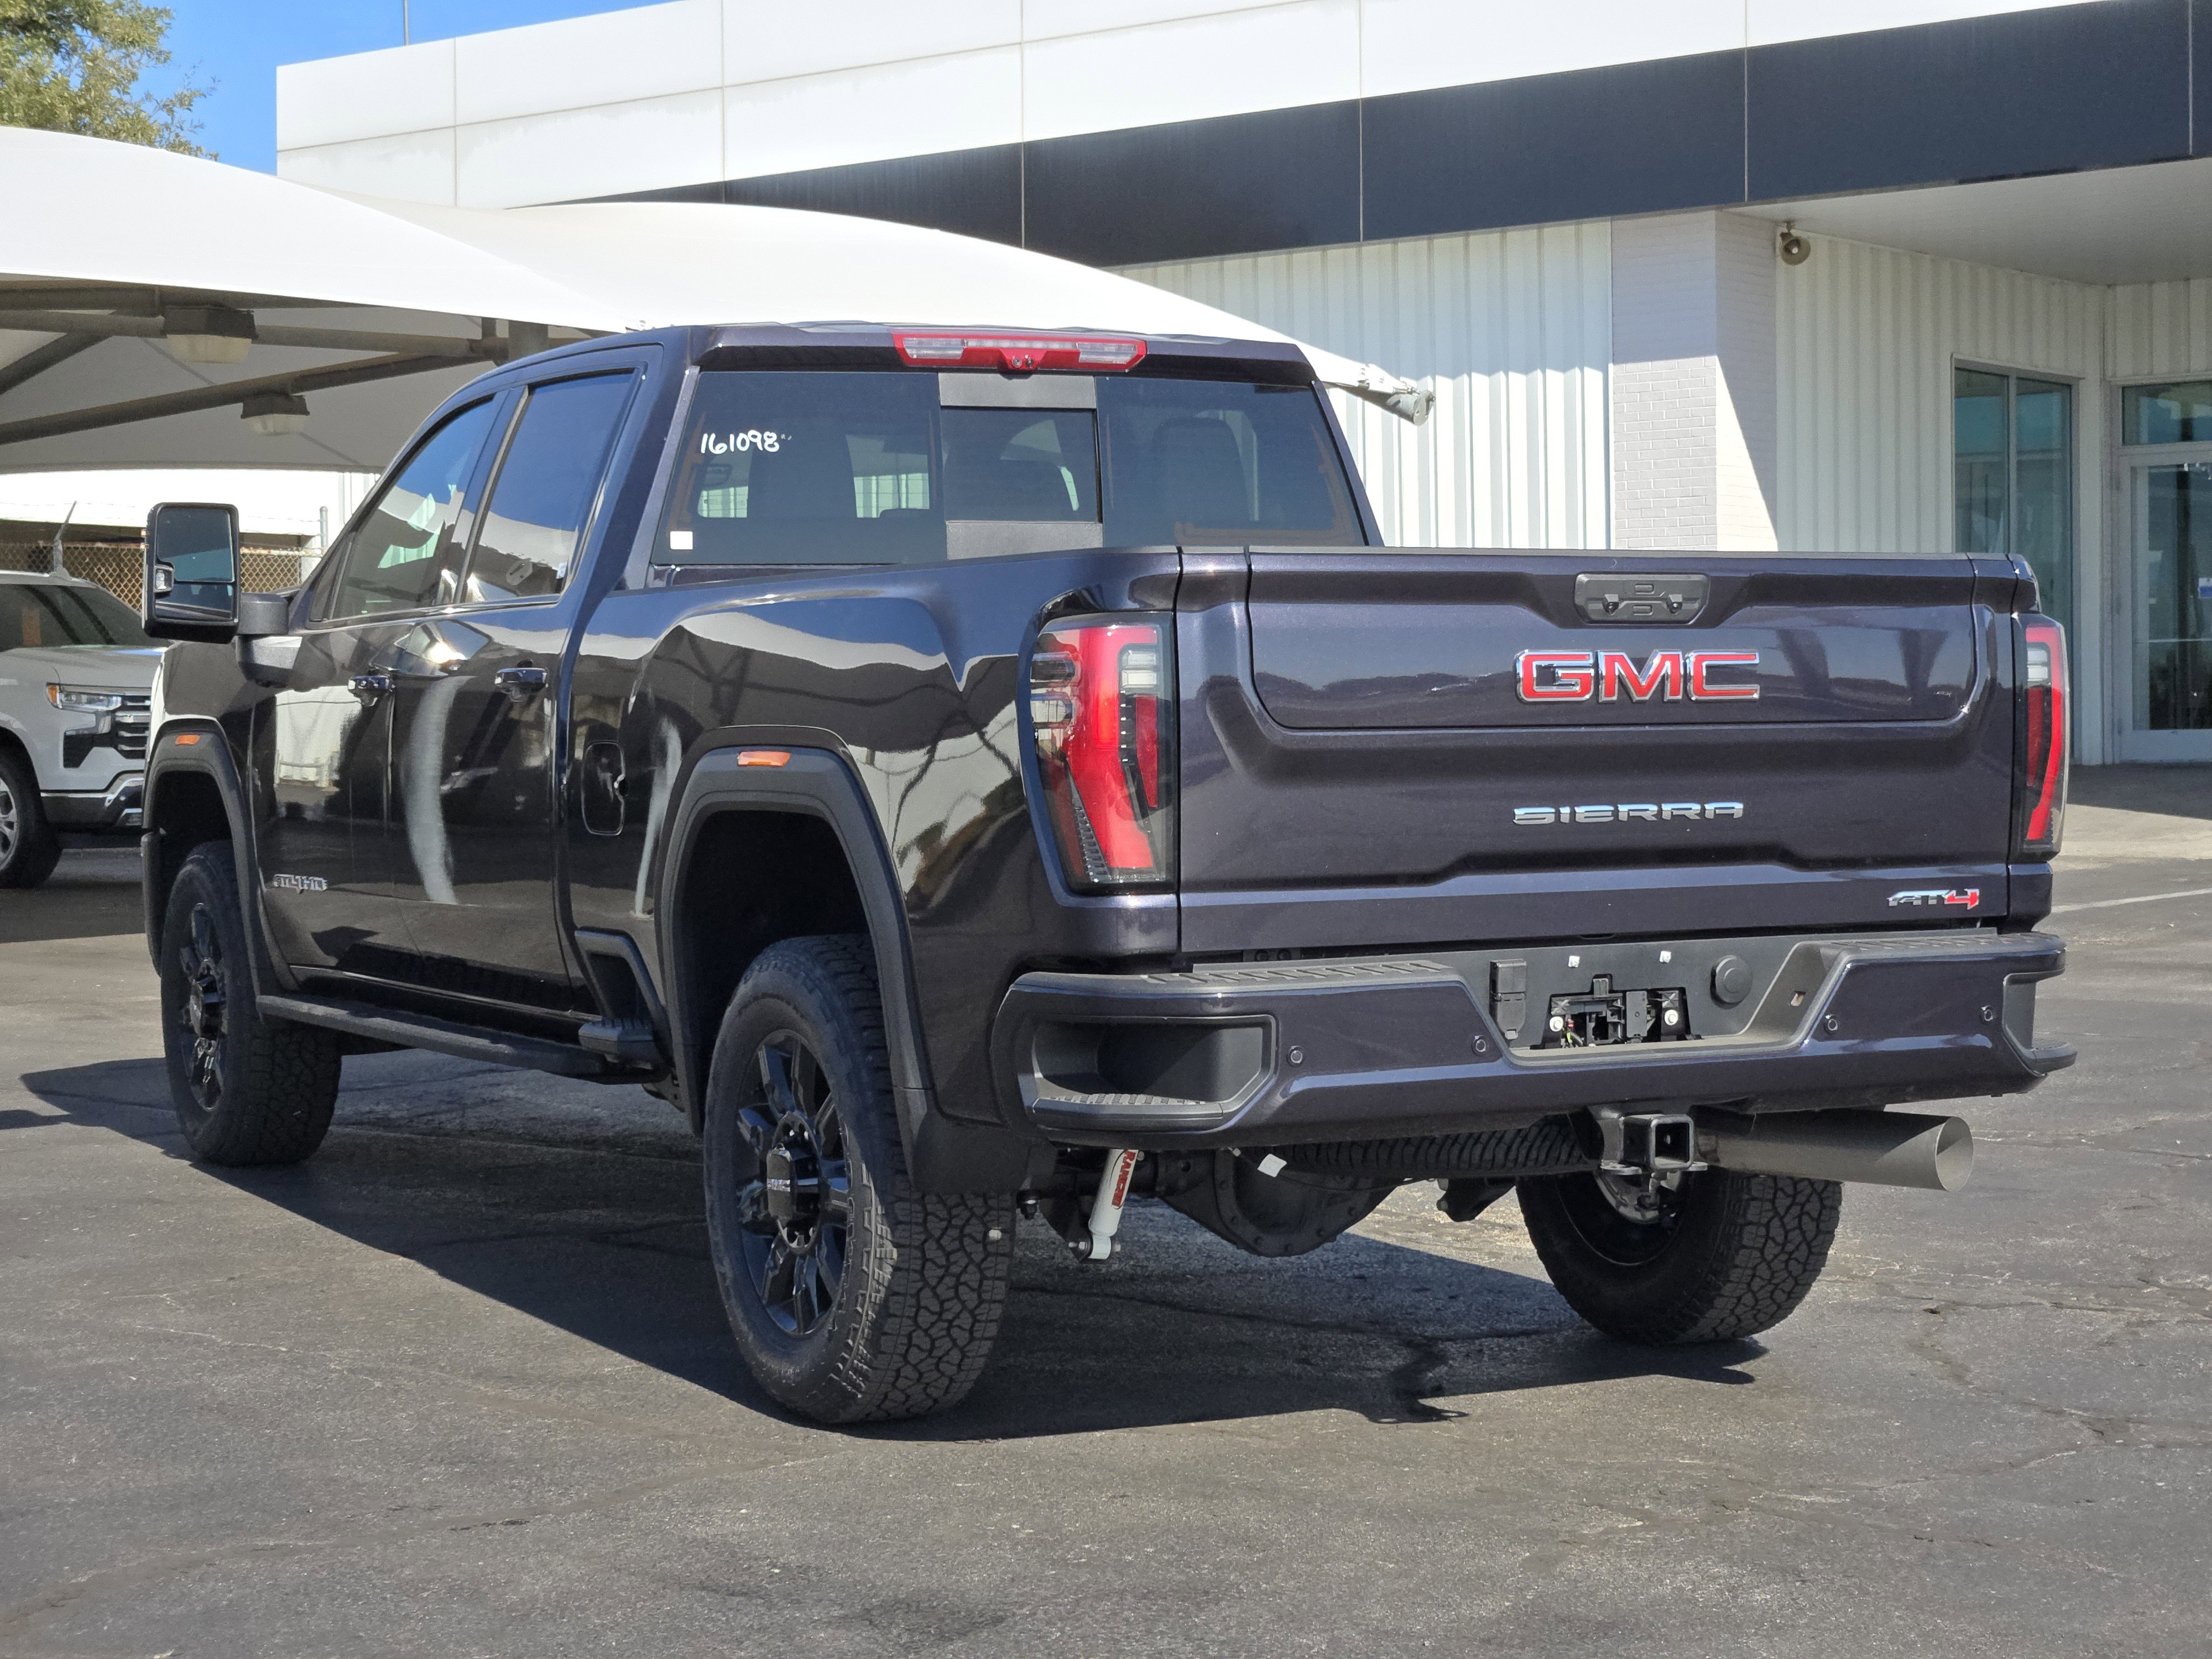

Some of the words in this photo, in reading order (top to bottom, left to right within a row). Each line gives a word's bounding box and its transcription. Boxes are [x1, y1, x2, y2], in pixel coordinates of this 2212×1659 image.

[701, 430, 780, 454] 161098
[1514, 649, 1760, 702] GMC
[1512, 801, 1744, 825] SIERRA
[1887, 888, 1980, 910] AT4
